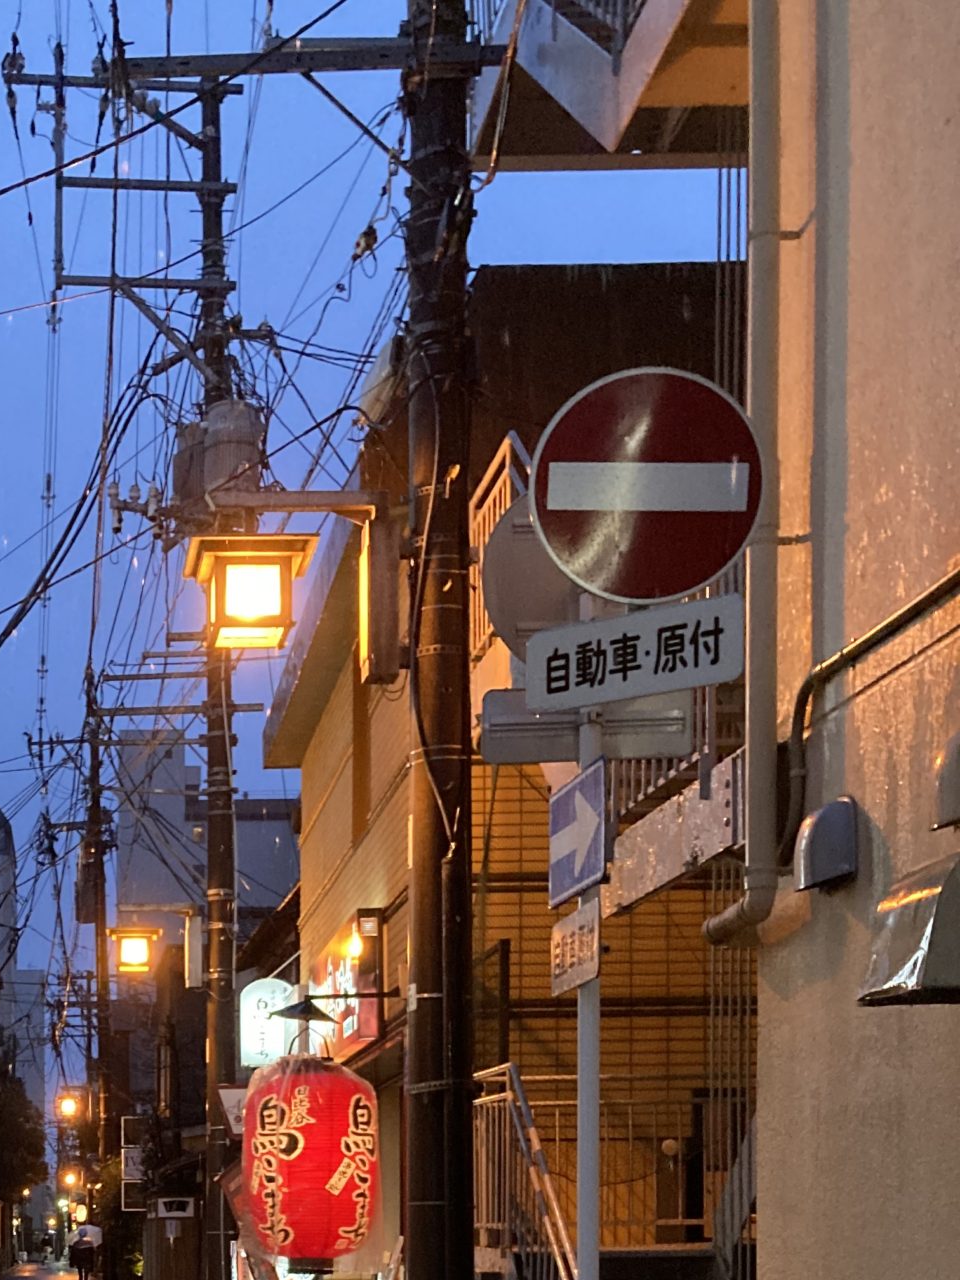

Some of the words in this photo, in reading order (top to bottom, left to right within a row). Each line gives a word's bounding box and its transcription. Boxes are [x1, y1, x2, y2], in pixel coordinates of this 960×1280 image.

[546, 616, 724, 694] 自動車・原付
